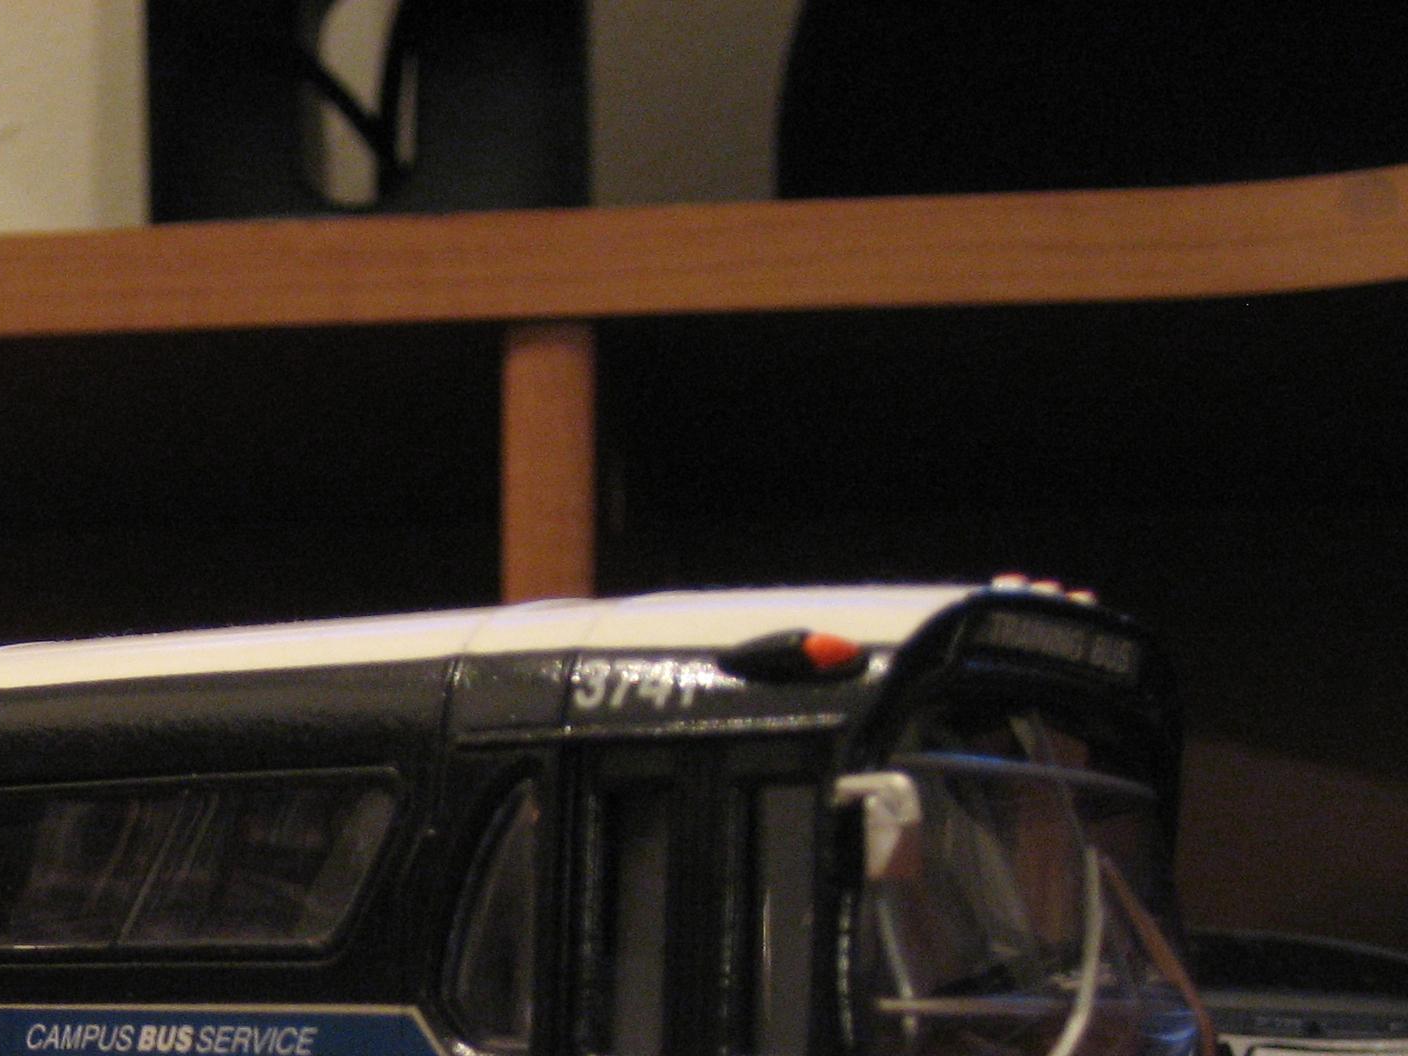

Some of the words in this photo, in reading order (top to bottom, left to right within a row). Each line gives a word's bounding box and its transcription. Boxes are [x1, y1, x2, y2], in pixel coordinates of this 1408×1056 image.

[574, 658, 697, 708] 3741
[25, 1023, 133, 1051] CAMPUS
[138, 1024, 195, 1052] BUS
[195, 1026, 318, 1056] SERVICE
